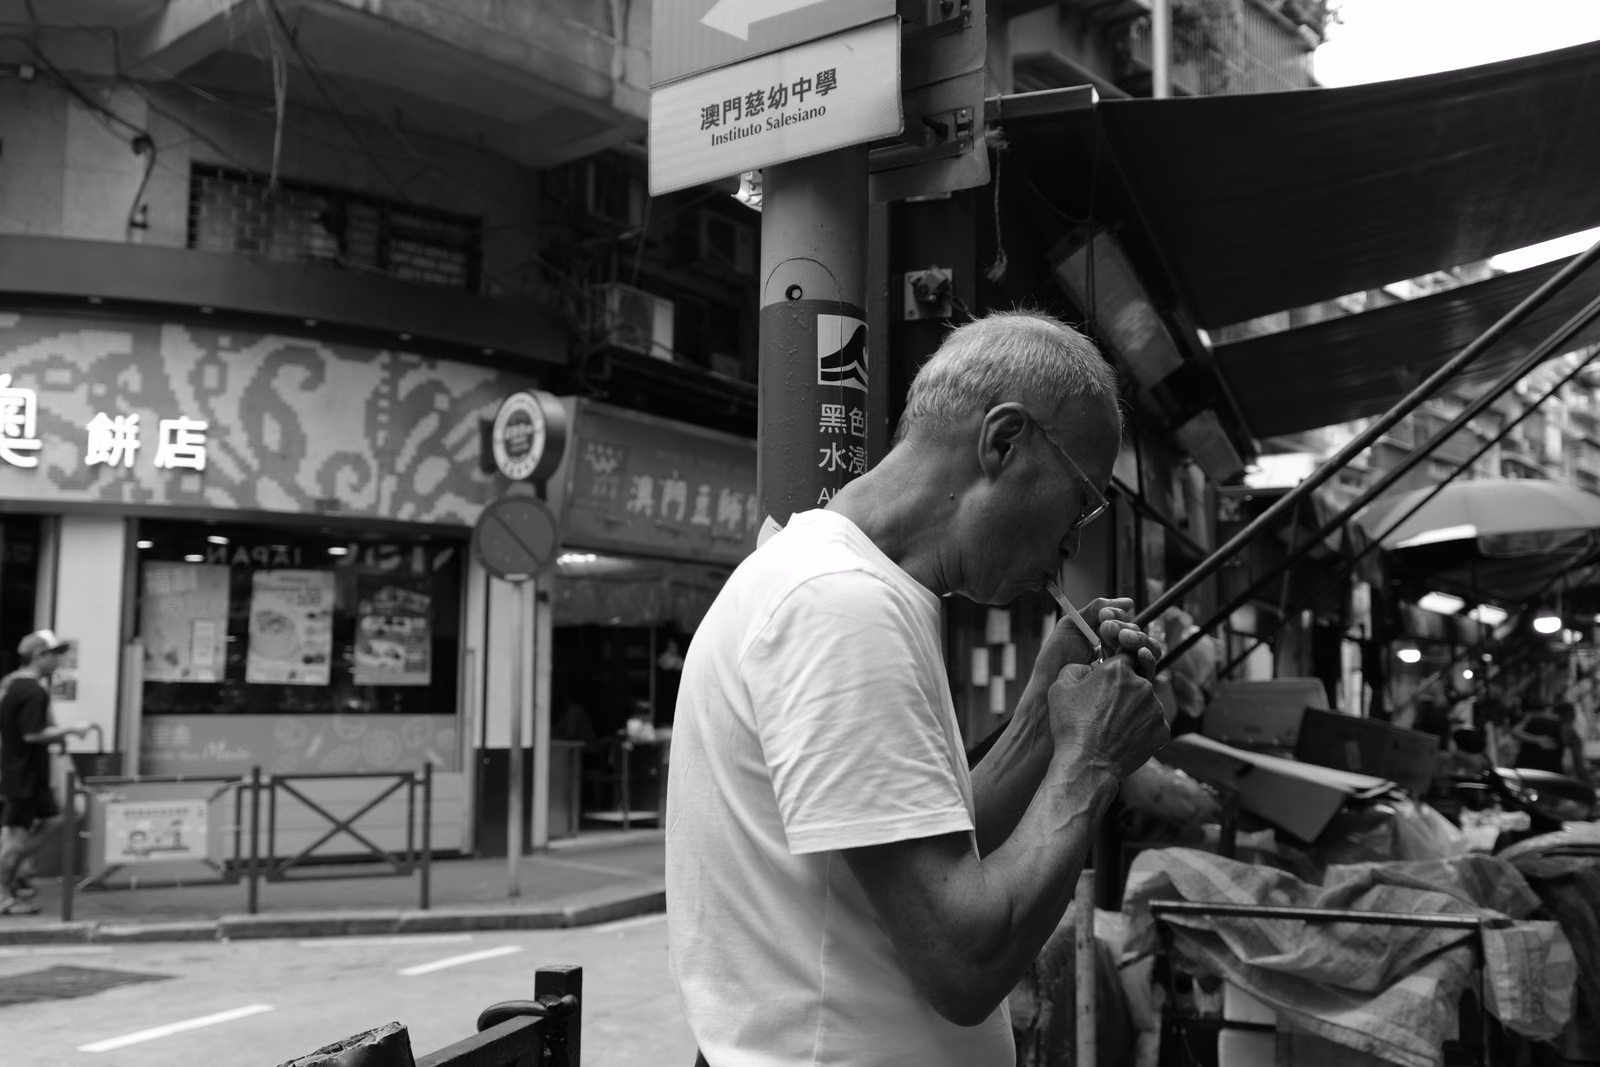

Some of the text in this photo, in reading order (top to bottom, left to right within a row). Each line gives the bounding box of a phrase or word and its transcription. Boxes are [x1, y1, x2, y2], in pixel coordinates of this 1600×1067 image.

[700, 68, 838, 131] 澳門慈幼中學
[711, 105, 826, 146] Instituto Salesiano
[818, 403, 869, 440] 黑色
[818, 442, 868, 476] 水浸
